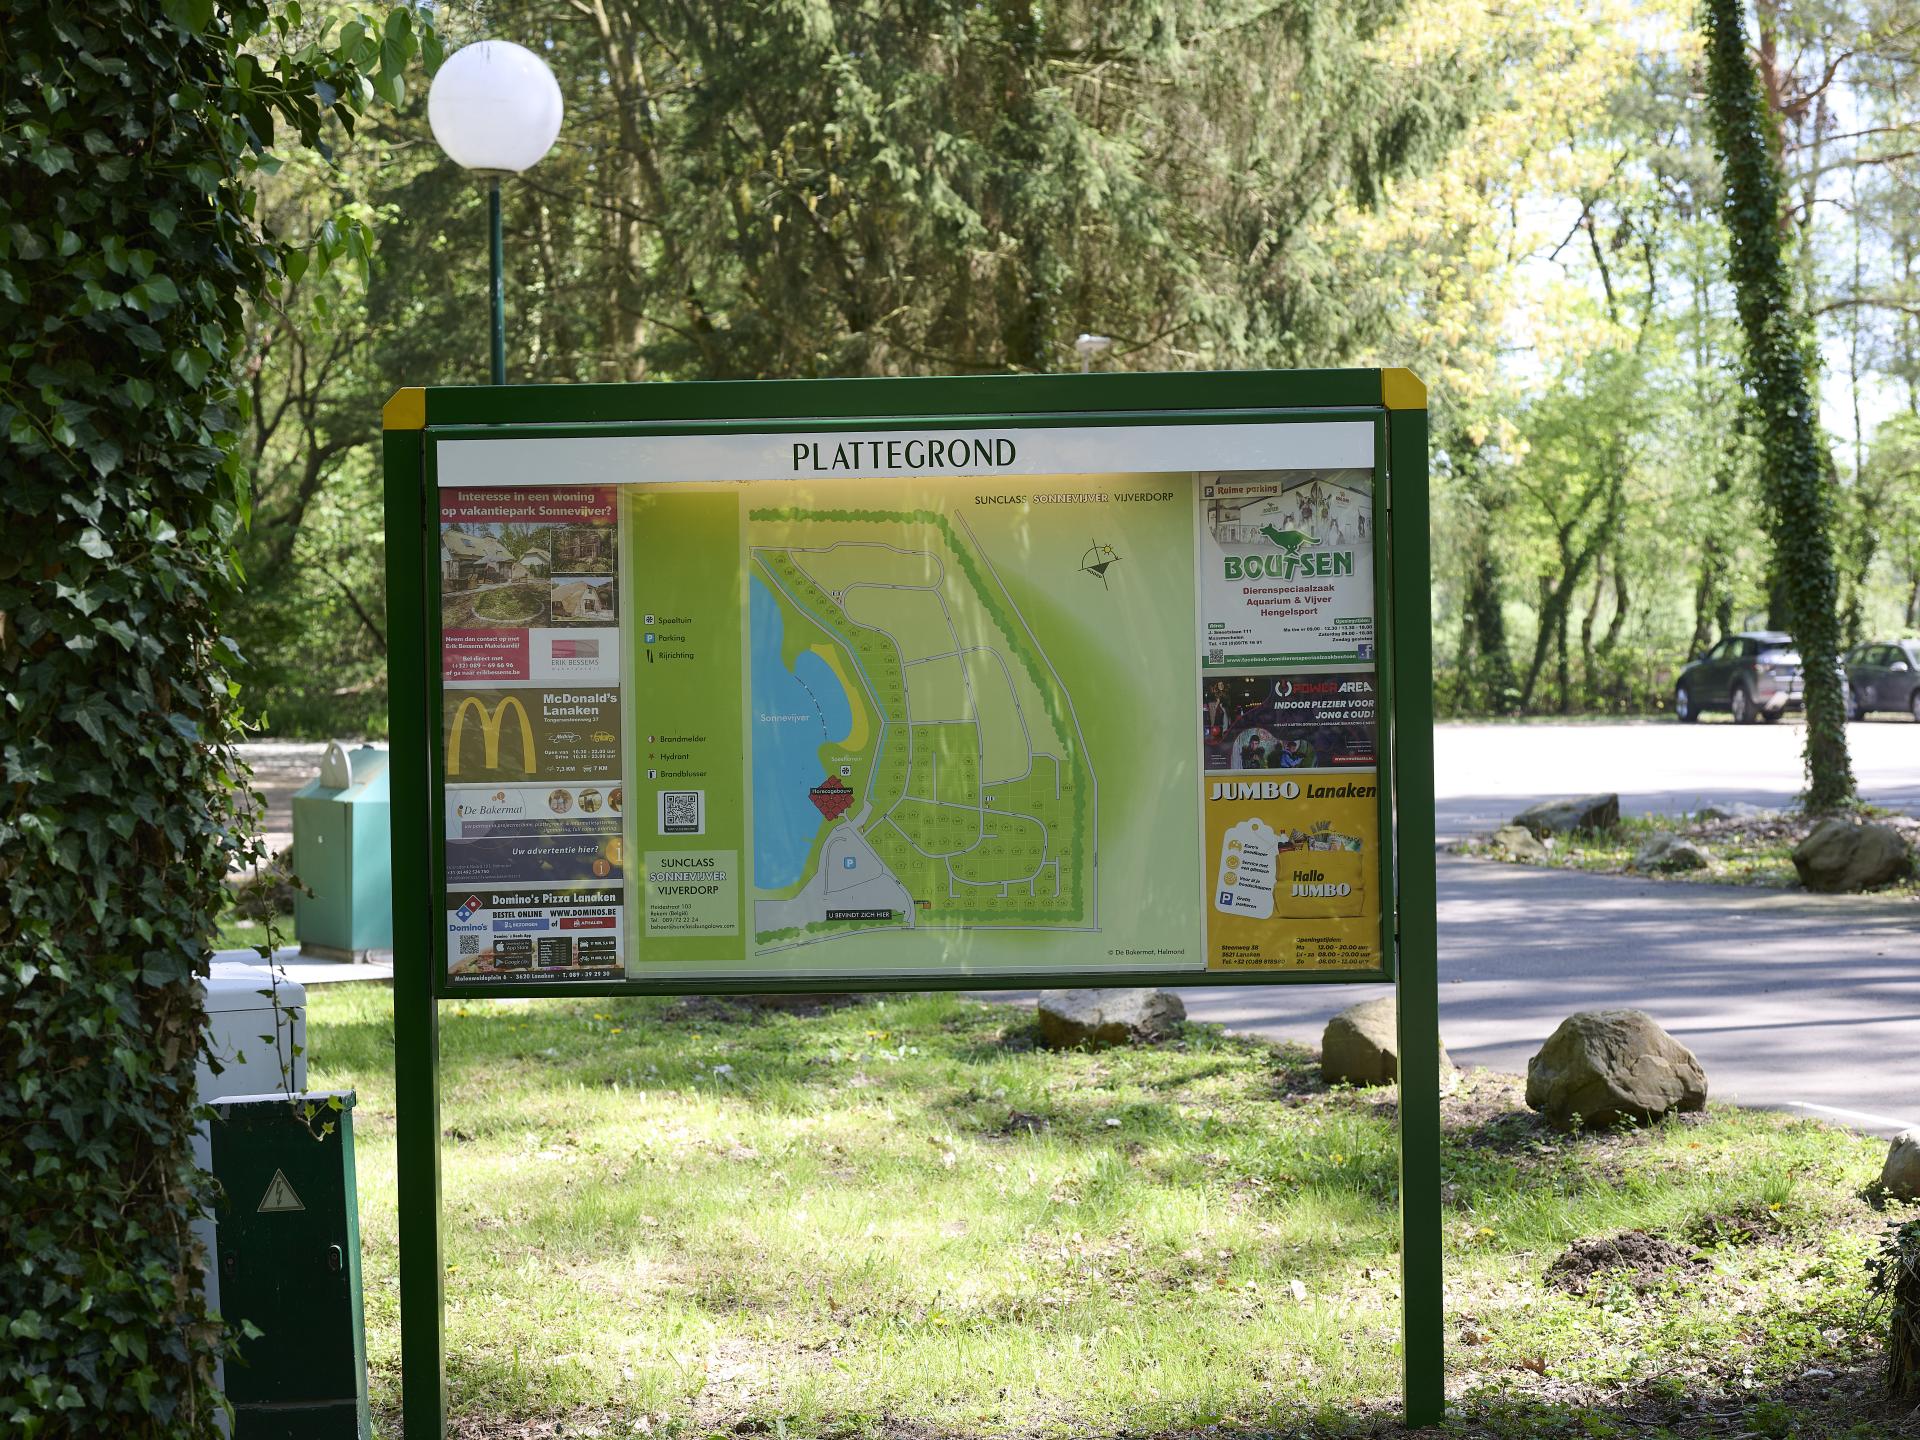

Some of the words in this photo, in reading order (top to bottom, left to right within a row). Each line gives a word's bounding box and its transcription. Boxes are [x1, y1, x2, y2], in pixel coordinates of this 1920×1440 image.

[793, 438, 1016, 471] PLATTEGROND
[1218, 486, 1244, 495] Ruime
[1246, 484, 1278, 496] parking
[458, 492, 510, 502] Interesse
[514, 492, 524, 501] in
[553, 491, 595, 503] woning
[975, 495, 1027, 505] SUNCLASS
[1032, 493, 1109, 504] SONNEVIJVER
[1114, 492, 1174, 502] VIJVERDORP
[441, 508, 457, 518] op
[460, 506, 536, 518] vakantiepark
[539, 506, 612, 517] Sonnevijver?
[1223, 551, 1355, 583] BOUTSEN
[1243, 584, 1335, 596] Dierenspeciaalzaak
[1246, 598, 1290, 607] Aquarium
[1304, 596, 1332, 605] Vijver
[1261, 608, 1318, 618] Hengelsport
[658, 617, 692, 626] Speeltuin
[658, 634, 686, 643] Parking
[658, 652, 694, 661] Rijrichting
[1338, 681, 1373, 693] AREA
[544, 694, 617, 704] McDonald's
[1274, 701, 1310, 710] INDOOR
[1312, 700, 1347, 708] PLEZIER
[1348, 700, 1374, 708] VOOR
[544, 706, 600, 716] Lanaken
[1315, 710, 1342, 719] JONG
[1343, 710, 1349, 718] &
[1350, 710, 1375, 718] OUD!
[760, 713, 811, 724] Sonnevijver
[660, 754, 689, 762] Hydrant
[1210, 781, 1300, 802] JUMBO
[1306, 782, 1377, 799] Lanaken
[464, 806, 477, 816] De
[480, 805, 523, 816] Bakermat
[512, 848, 526, 856] Uw
[528, 846, 576, 855] advertentie
[578, 846, 599, 854] hier?
[661, 858, 715, 868] SUNCLASS
[650, 872, 727, 882] SONNEVIJVER
[1292, 871, 1324, 882] Hallo
[658, 886, 719, 895] VIJVERDORP
[1291, 882, 1352, 898] JUMBO
[492, 894, 540, 905] Domino's
[542, 894, 570, 904] Pizza
[573, 892, 616, 903] Lanaken
[492, 911, 516, 919] BESTEL
[518, 910, 542, 918] ONLINE
[550, 909, 616, 918] WWW.DOMINOS.BE
[450, 923, 488, 932] Domino's
[552, 920, 558, 928] of
